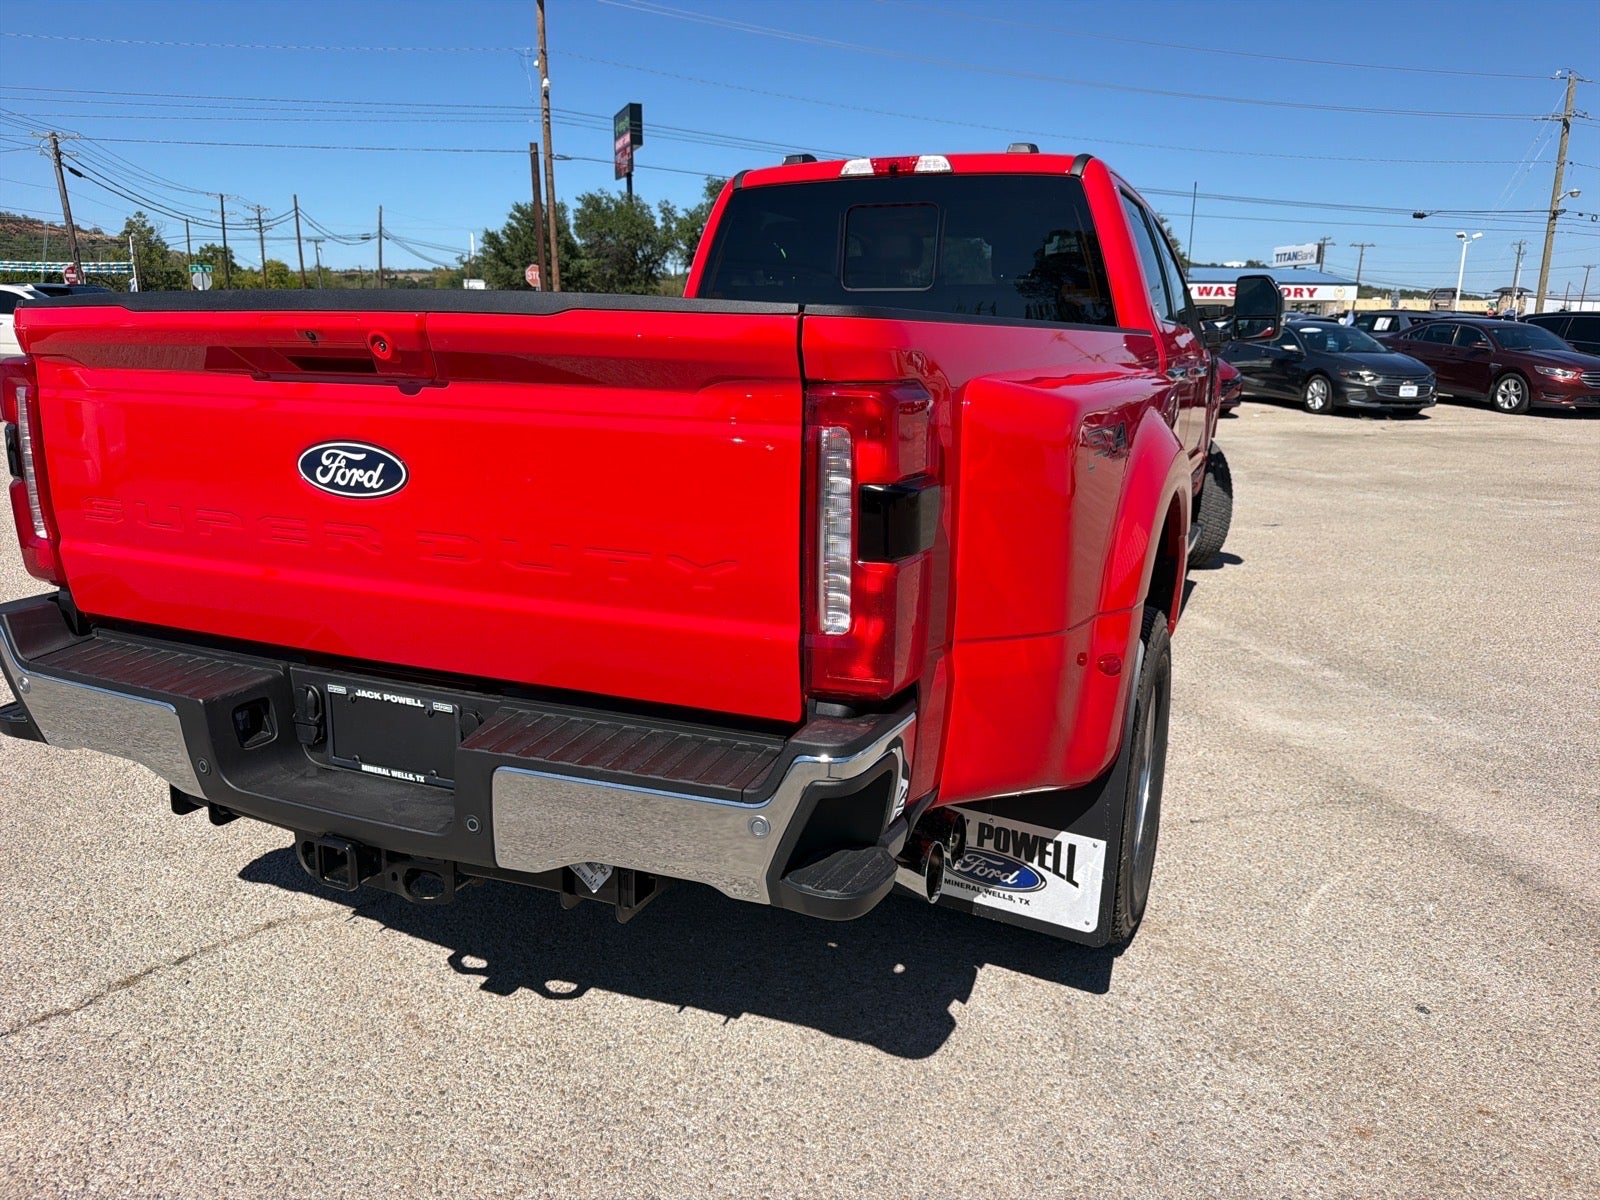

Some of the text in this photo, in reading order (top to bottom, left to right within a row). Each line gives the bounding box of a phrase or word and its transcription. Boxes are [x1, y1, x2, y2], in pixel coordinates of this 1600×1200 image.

[1275, 250, 1315, 264] TITANBank
[527, 271, 540, 280] STO
[1197, 286, 1238, 297] WAS
[1281, 287, 1318, 298] DRY
[315, 448, 385, 490] Ford
[83, 496, 738, 590] SUPER DUTY
[355, 689, 382, 700] JACK
[383, 693, 425, 707] POWELL
[361, 764, 425, 783] MINERAL WELLS, TX
[976, 821, 1079, 889] POWELL
[959, 853, 1020, 885] Ford
[944, 878, 1030, 906] MINERAL WELLS, TX
